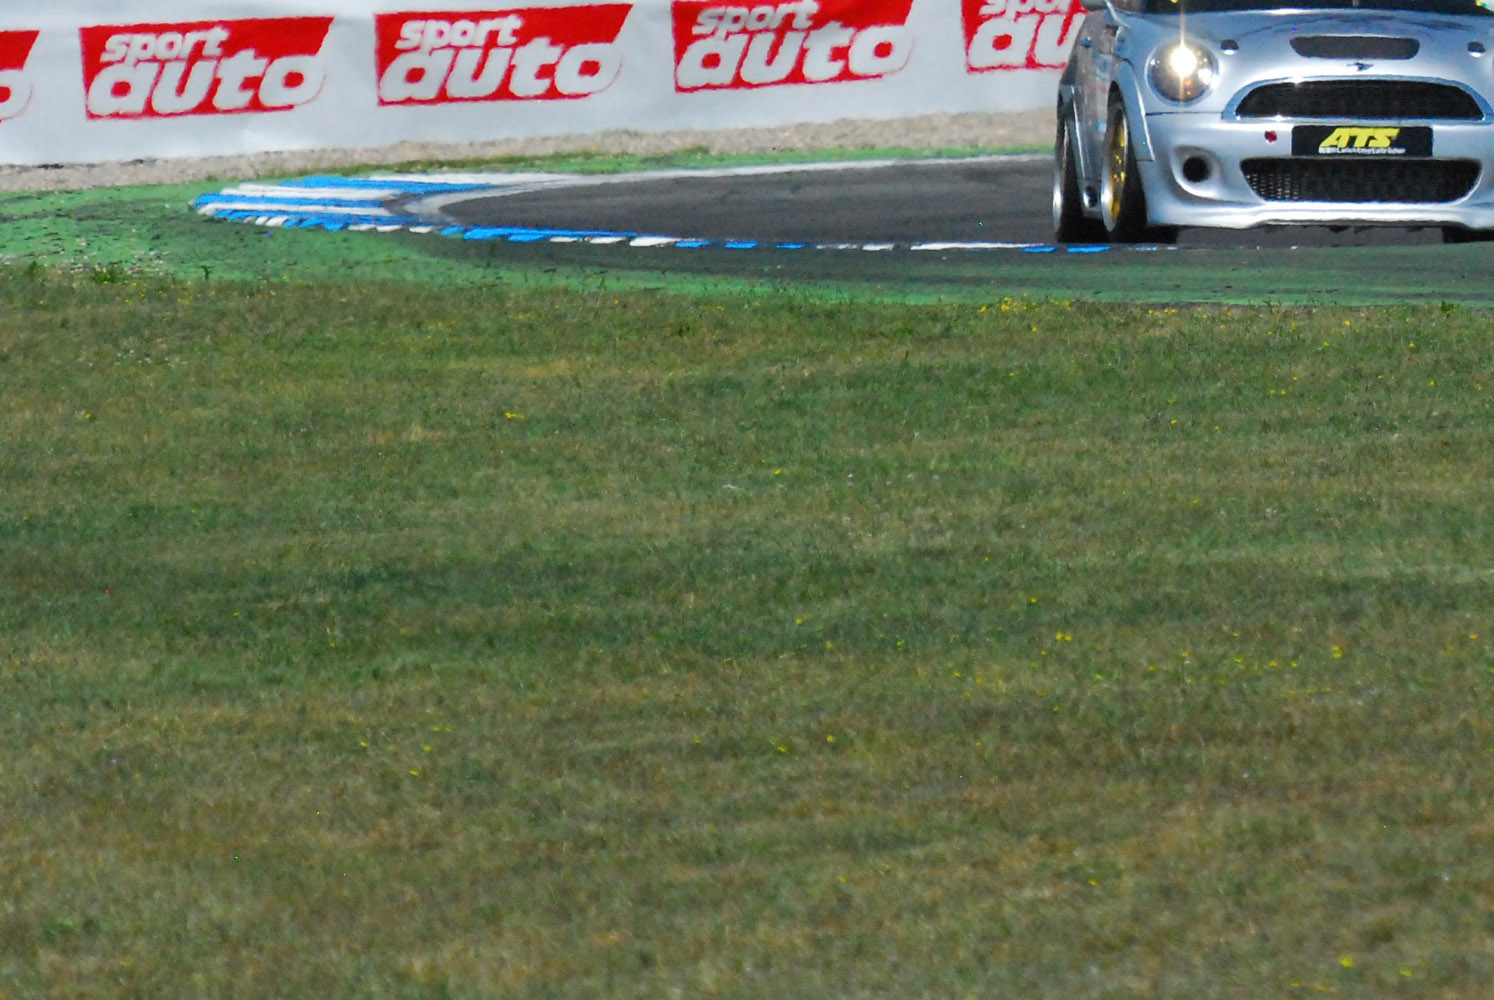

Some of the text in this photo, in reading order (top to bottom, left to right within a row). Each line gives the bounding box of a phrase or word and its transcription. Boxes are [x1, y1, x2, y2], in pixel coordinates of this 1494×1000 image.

[101, 26, 231, 66] sport
[395, 14, 524, 51] sport
[676, 20, 912, 88] auto
[86, 47, 326, 117] auto
[378, 36, 622, 101] auto
[1320, 127, 1400, 148] ATS
